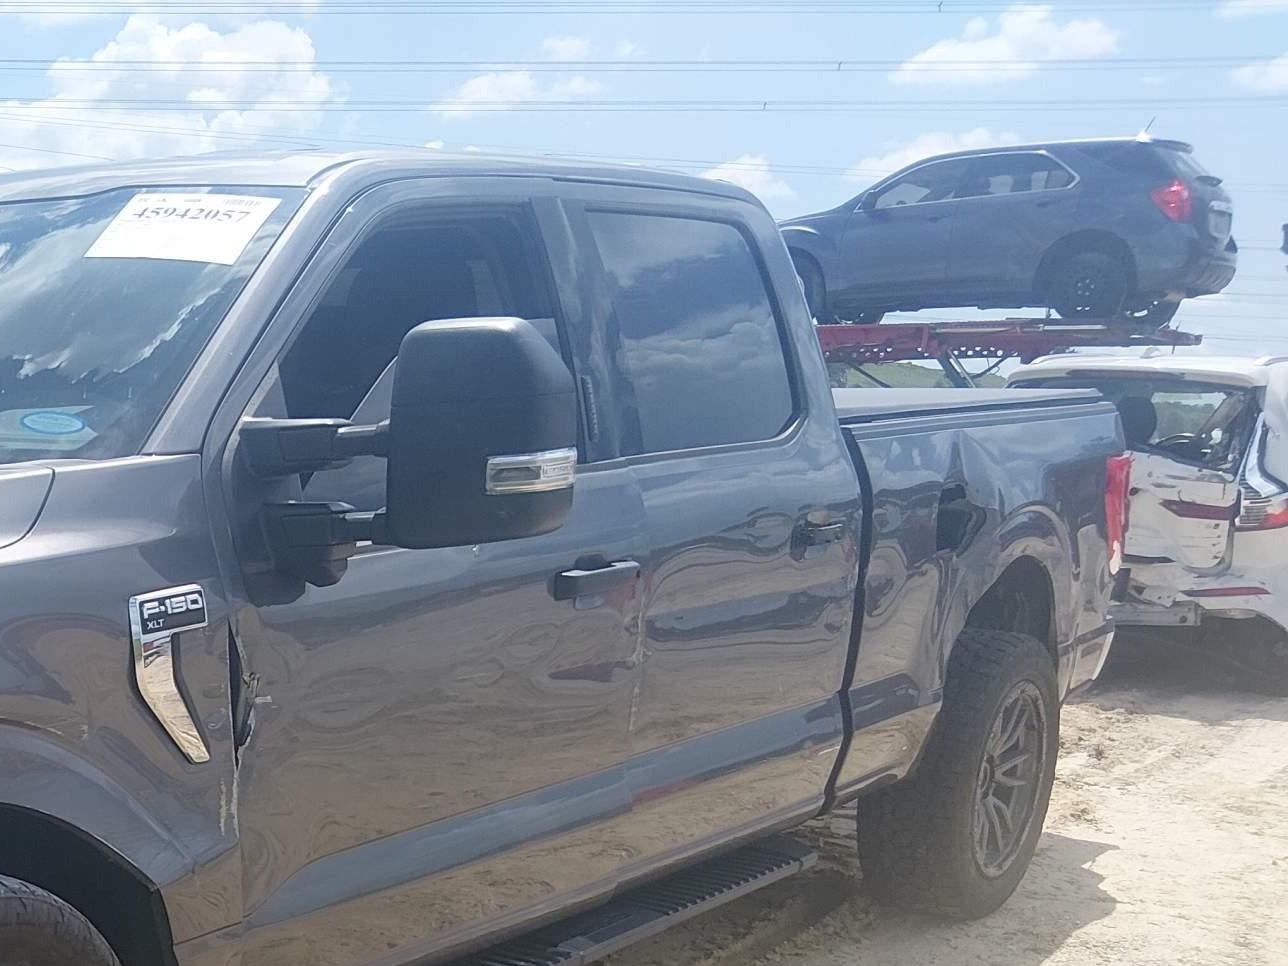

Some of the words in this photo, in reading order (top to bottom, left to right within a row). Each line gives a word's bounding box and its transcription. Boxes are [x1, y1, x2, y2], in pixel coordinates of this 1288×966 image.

[133, 207, 251, 222] 45942057
[143, 593, 203, 619] F-150
[147, 619, 164, 630] XLT
